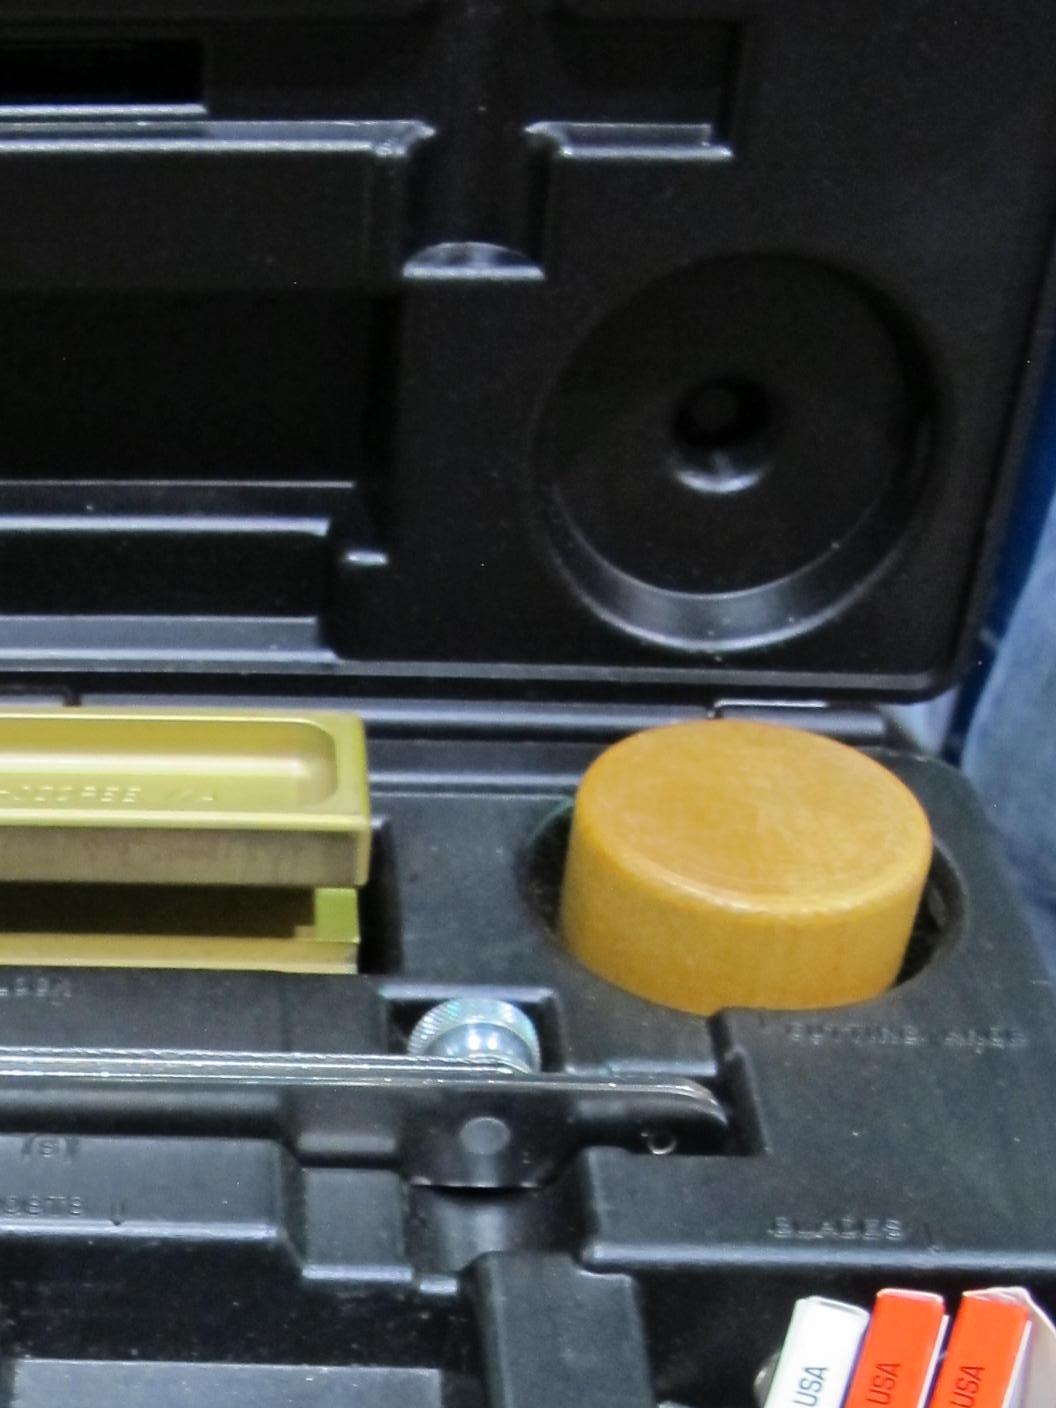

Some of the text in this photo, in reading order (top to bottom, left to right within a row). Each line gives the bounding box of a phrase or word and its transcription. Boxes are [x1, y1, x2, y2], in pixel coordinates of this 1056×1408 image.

[792, 1364, 830, 1408] USA
[866, 1360, 901, 1406] USA
[949, 1363, 986, 1408] USA
